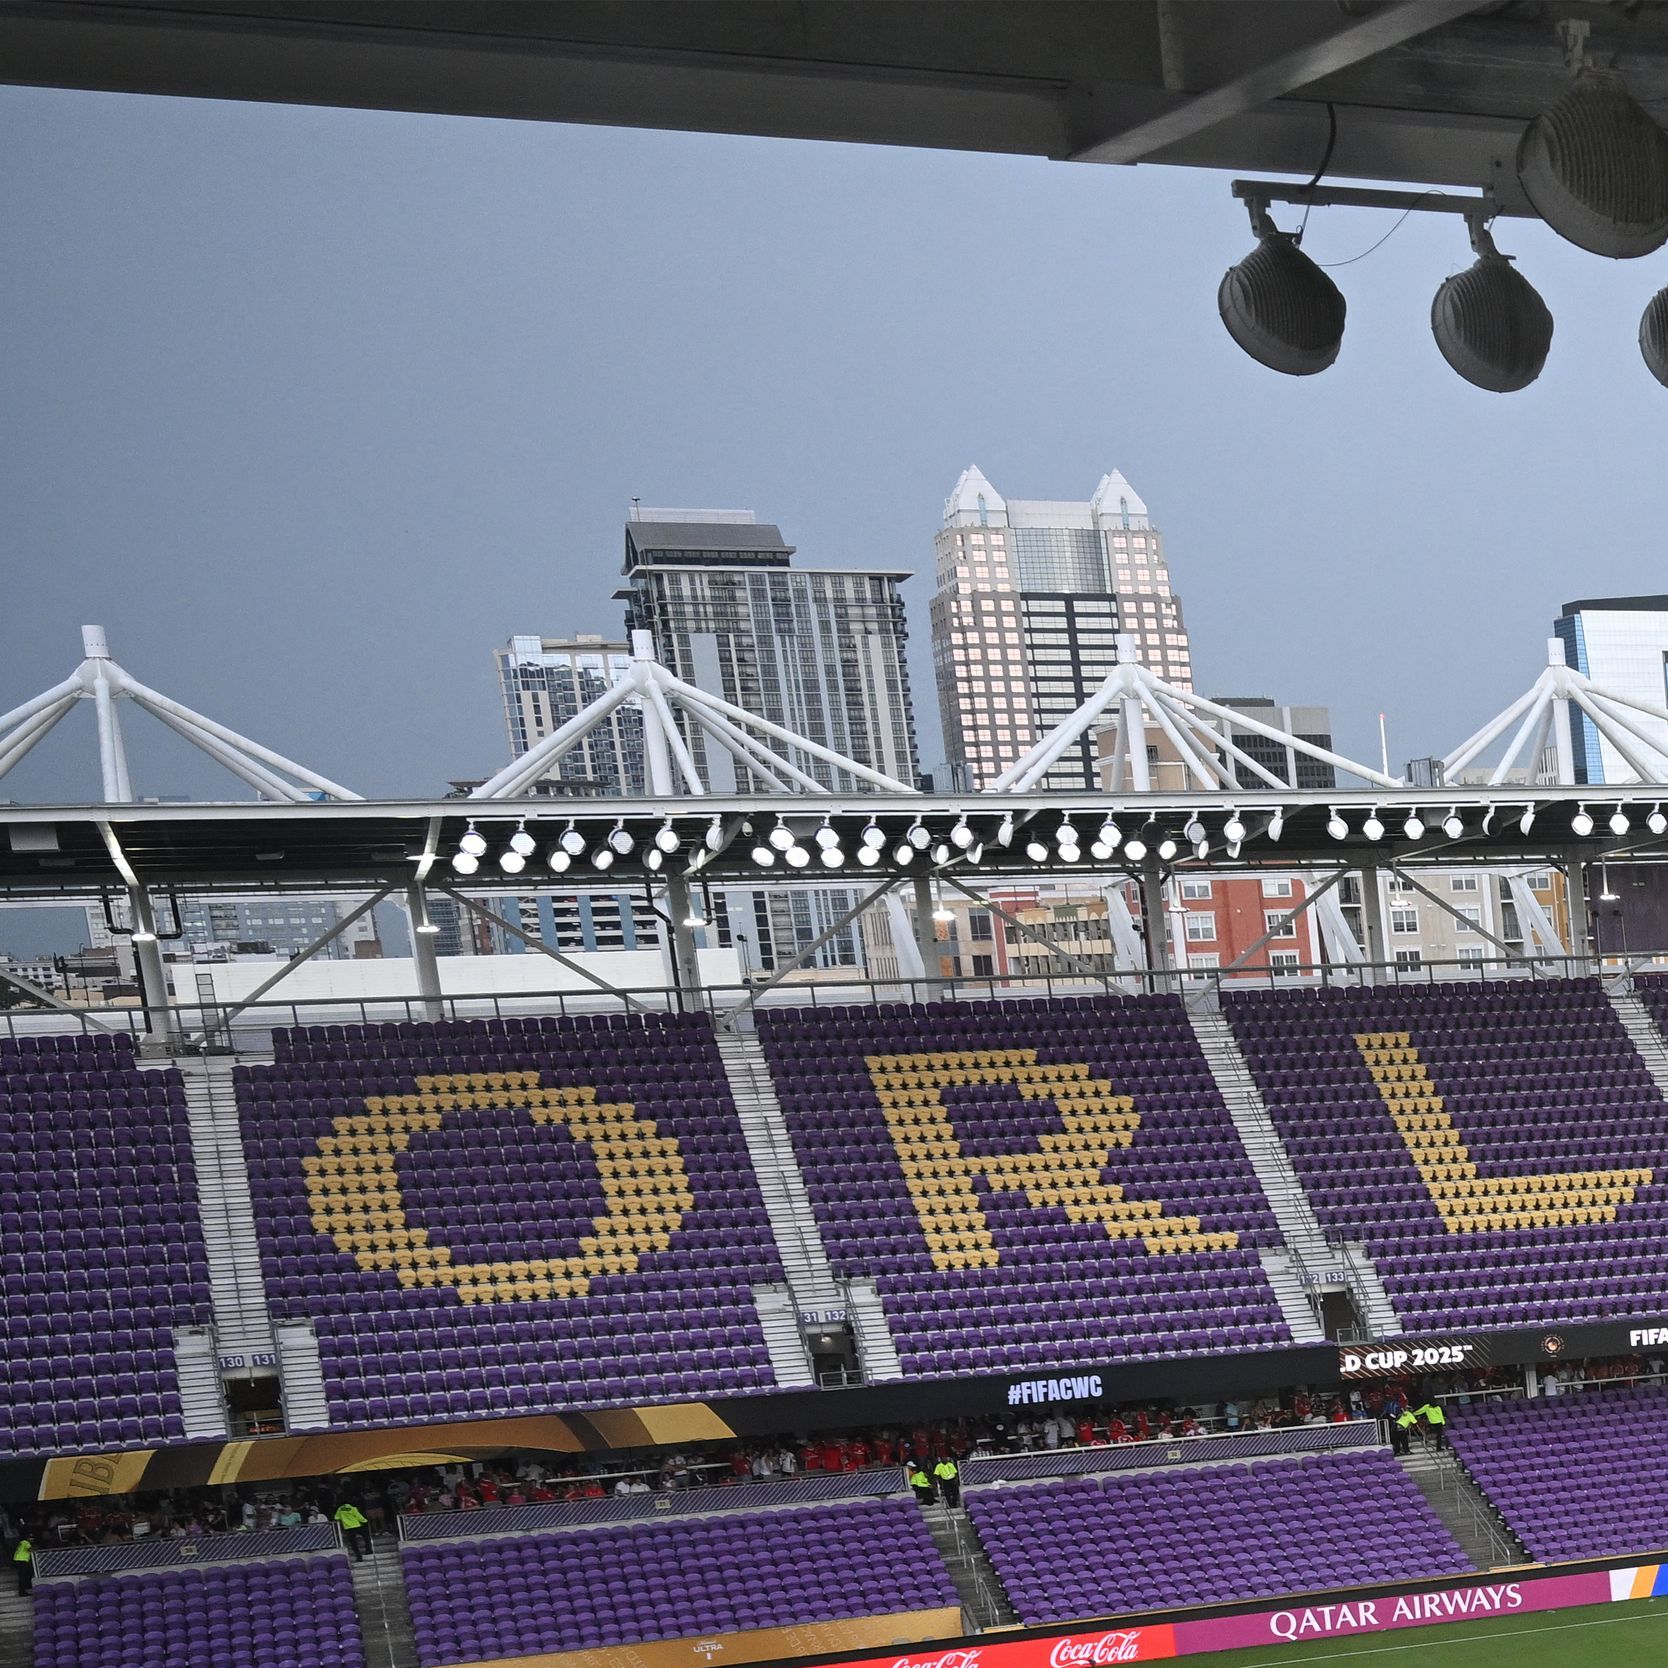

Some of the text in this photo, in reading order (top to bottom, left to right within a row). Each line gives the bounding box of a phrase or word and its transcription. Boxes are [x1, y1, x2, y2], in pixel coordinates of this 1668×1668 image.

[1326, 1272, 1345, 1282] 133
[800, 1312, 818, 1323] 31
[826, 1310, 846, 1321] 132
[219, 1357, 243, 1368] 130
[254, 1354, 276, 1365] 131
[1365, 1351, 1407, 1370] CUP
[1008, 1375, 1103, 1404] #FIFACWC
[1270, 1583, 1523, 1641] QATAR AIRWAYS
[693, 1643, 724, 1653] ULTRA
